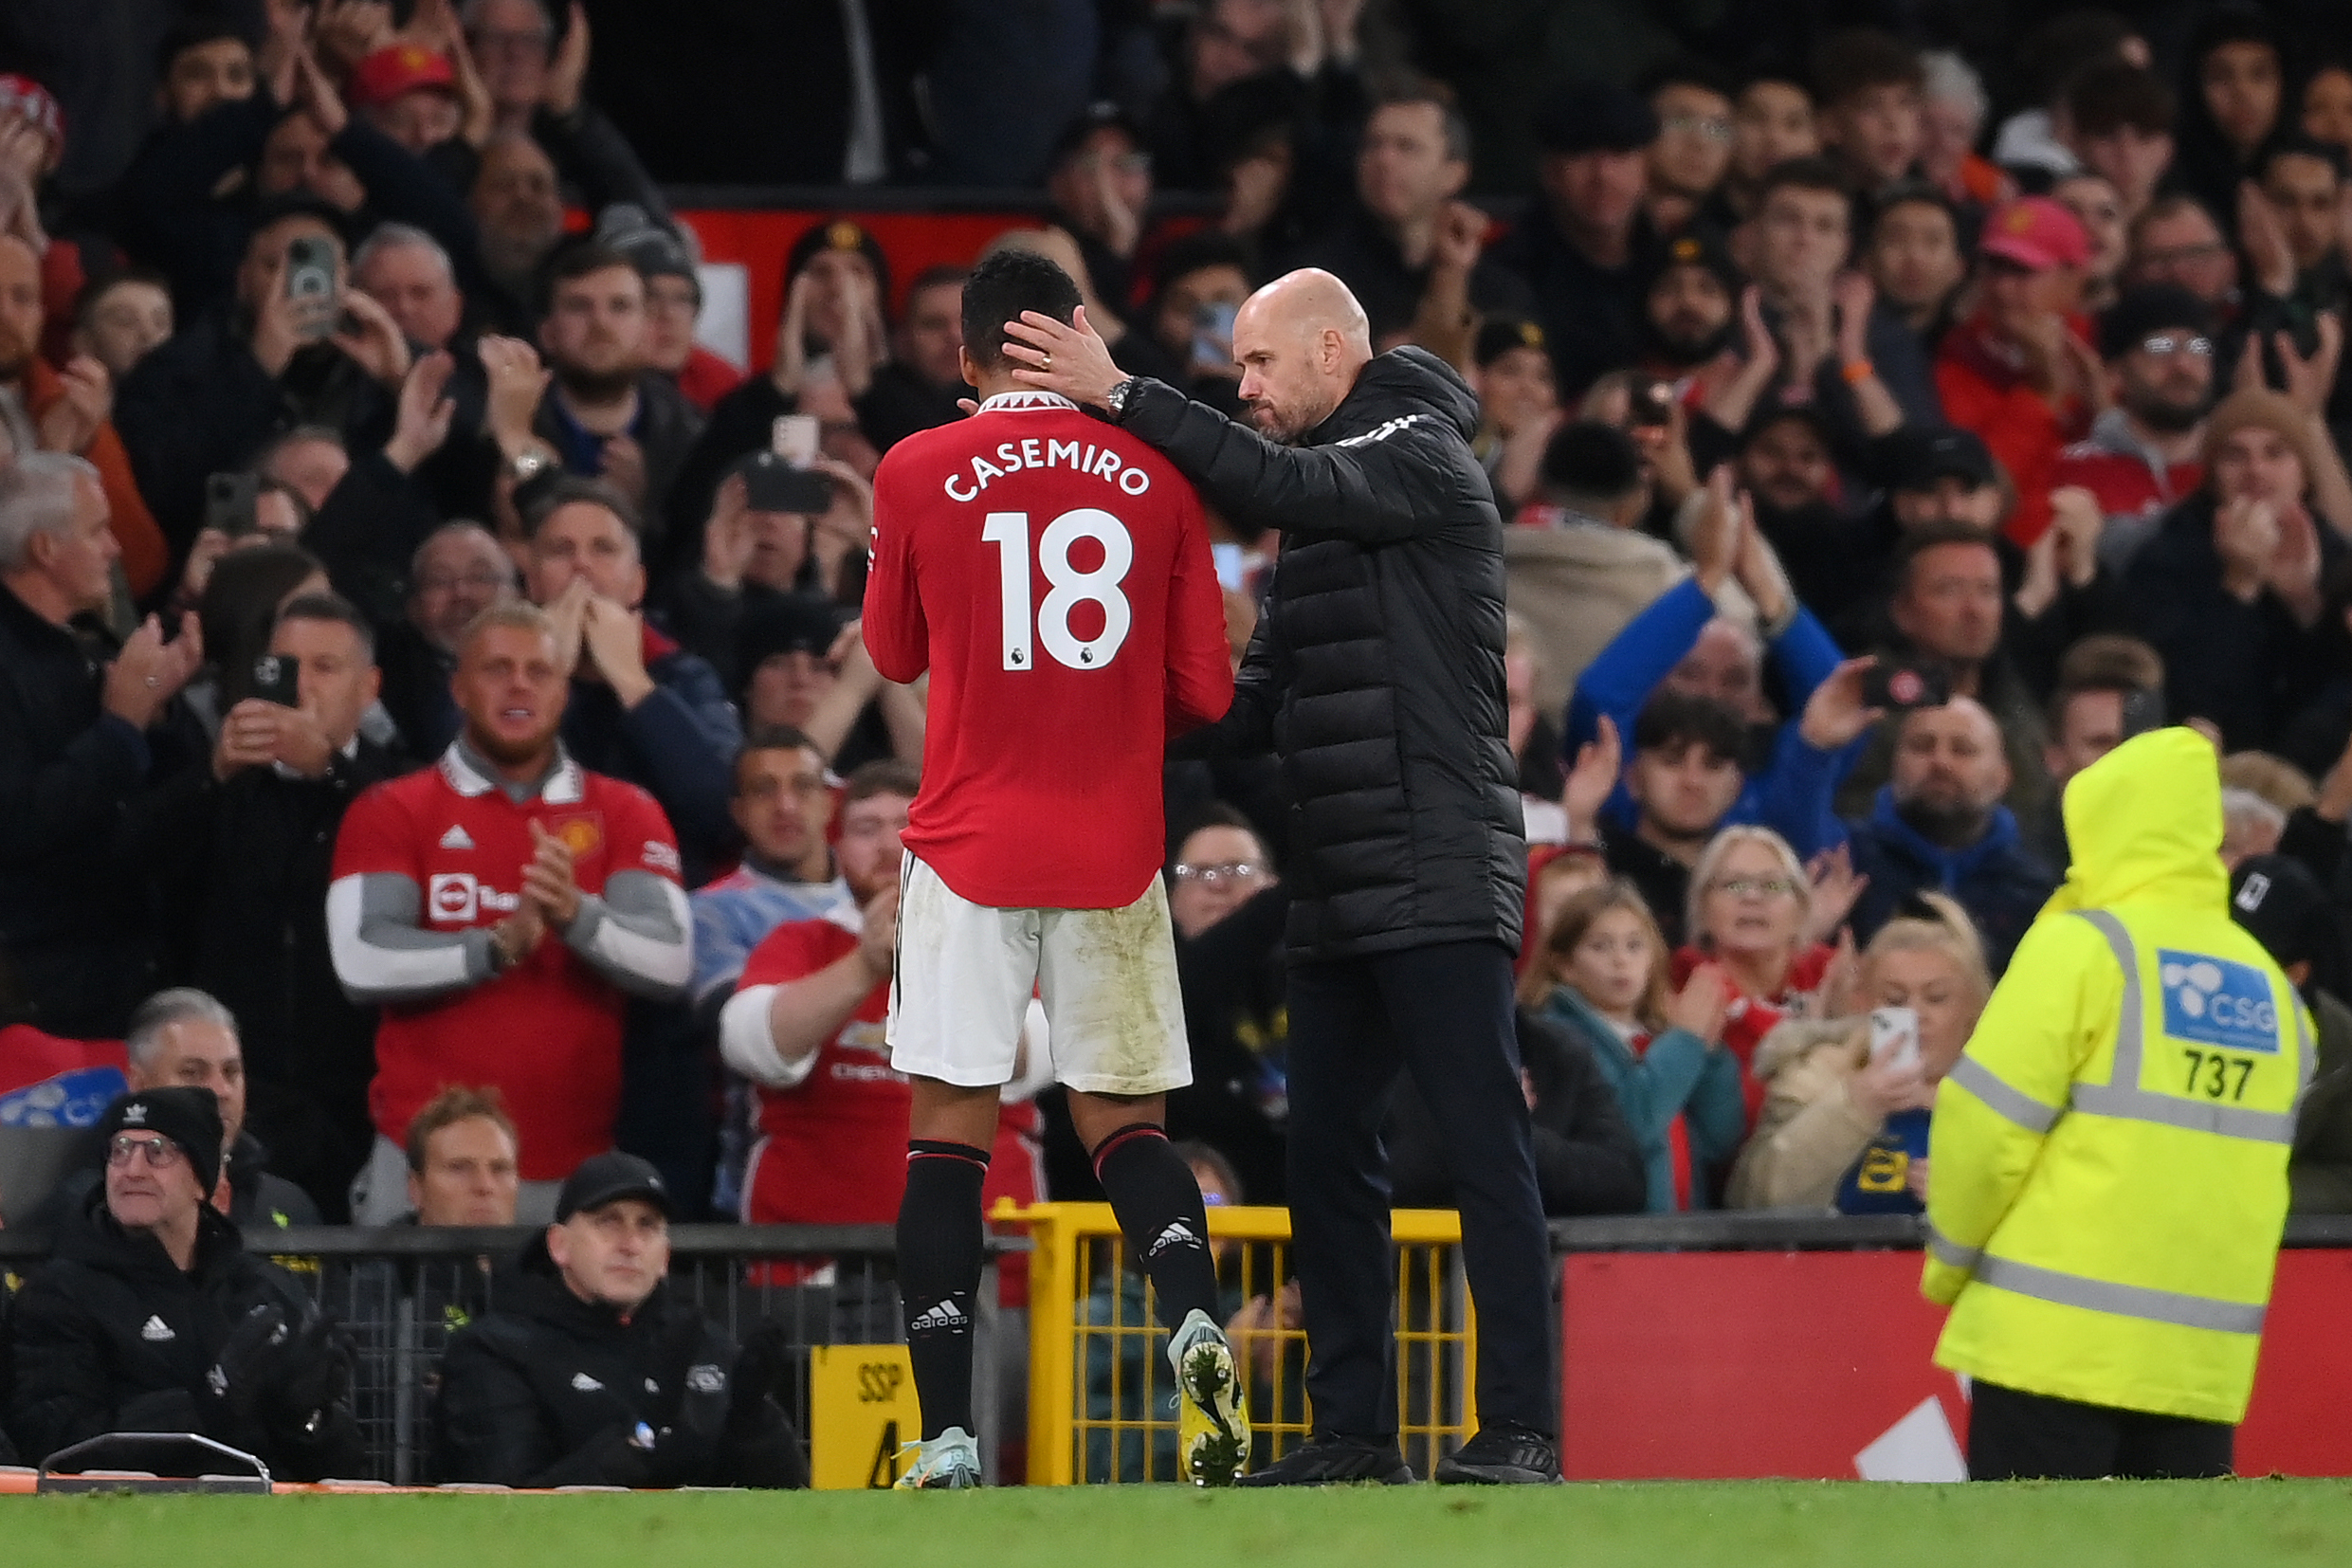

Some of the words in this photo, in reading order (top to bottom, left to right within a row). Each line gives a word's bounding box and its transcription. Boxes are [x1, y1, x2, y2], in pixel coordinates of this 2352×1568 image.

[944, 438, 1150, 502] CASEMIRO
[981, 507, 1134, 671] 18
[2210, 993, 2276, 1032] CSG
[2183, 1048, 2254, 1102] 737
[1148, 1233, 1202, 1257] adidas
[911, 1315, 968, 1330] adidas
[858, 1361, 903, 1404] SSP
